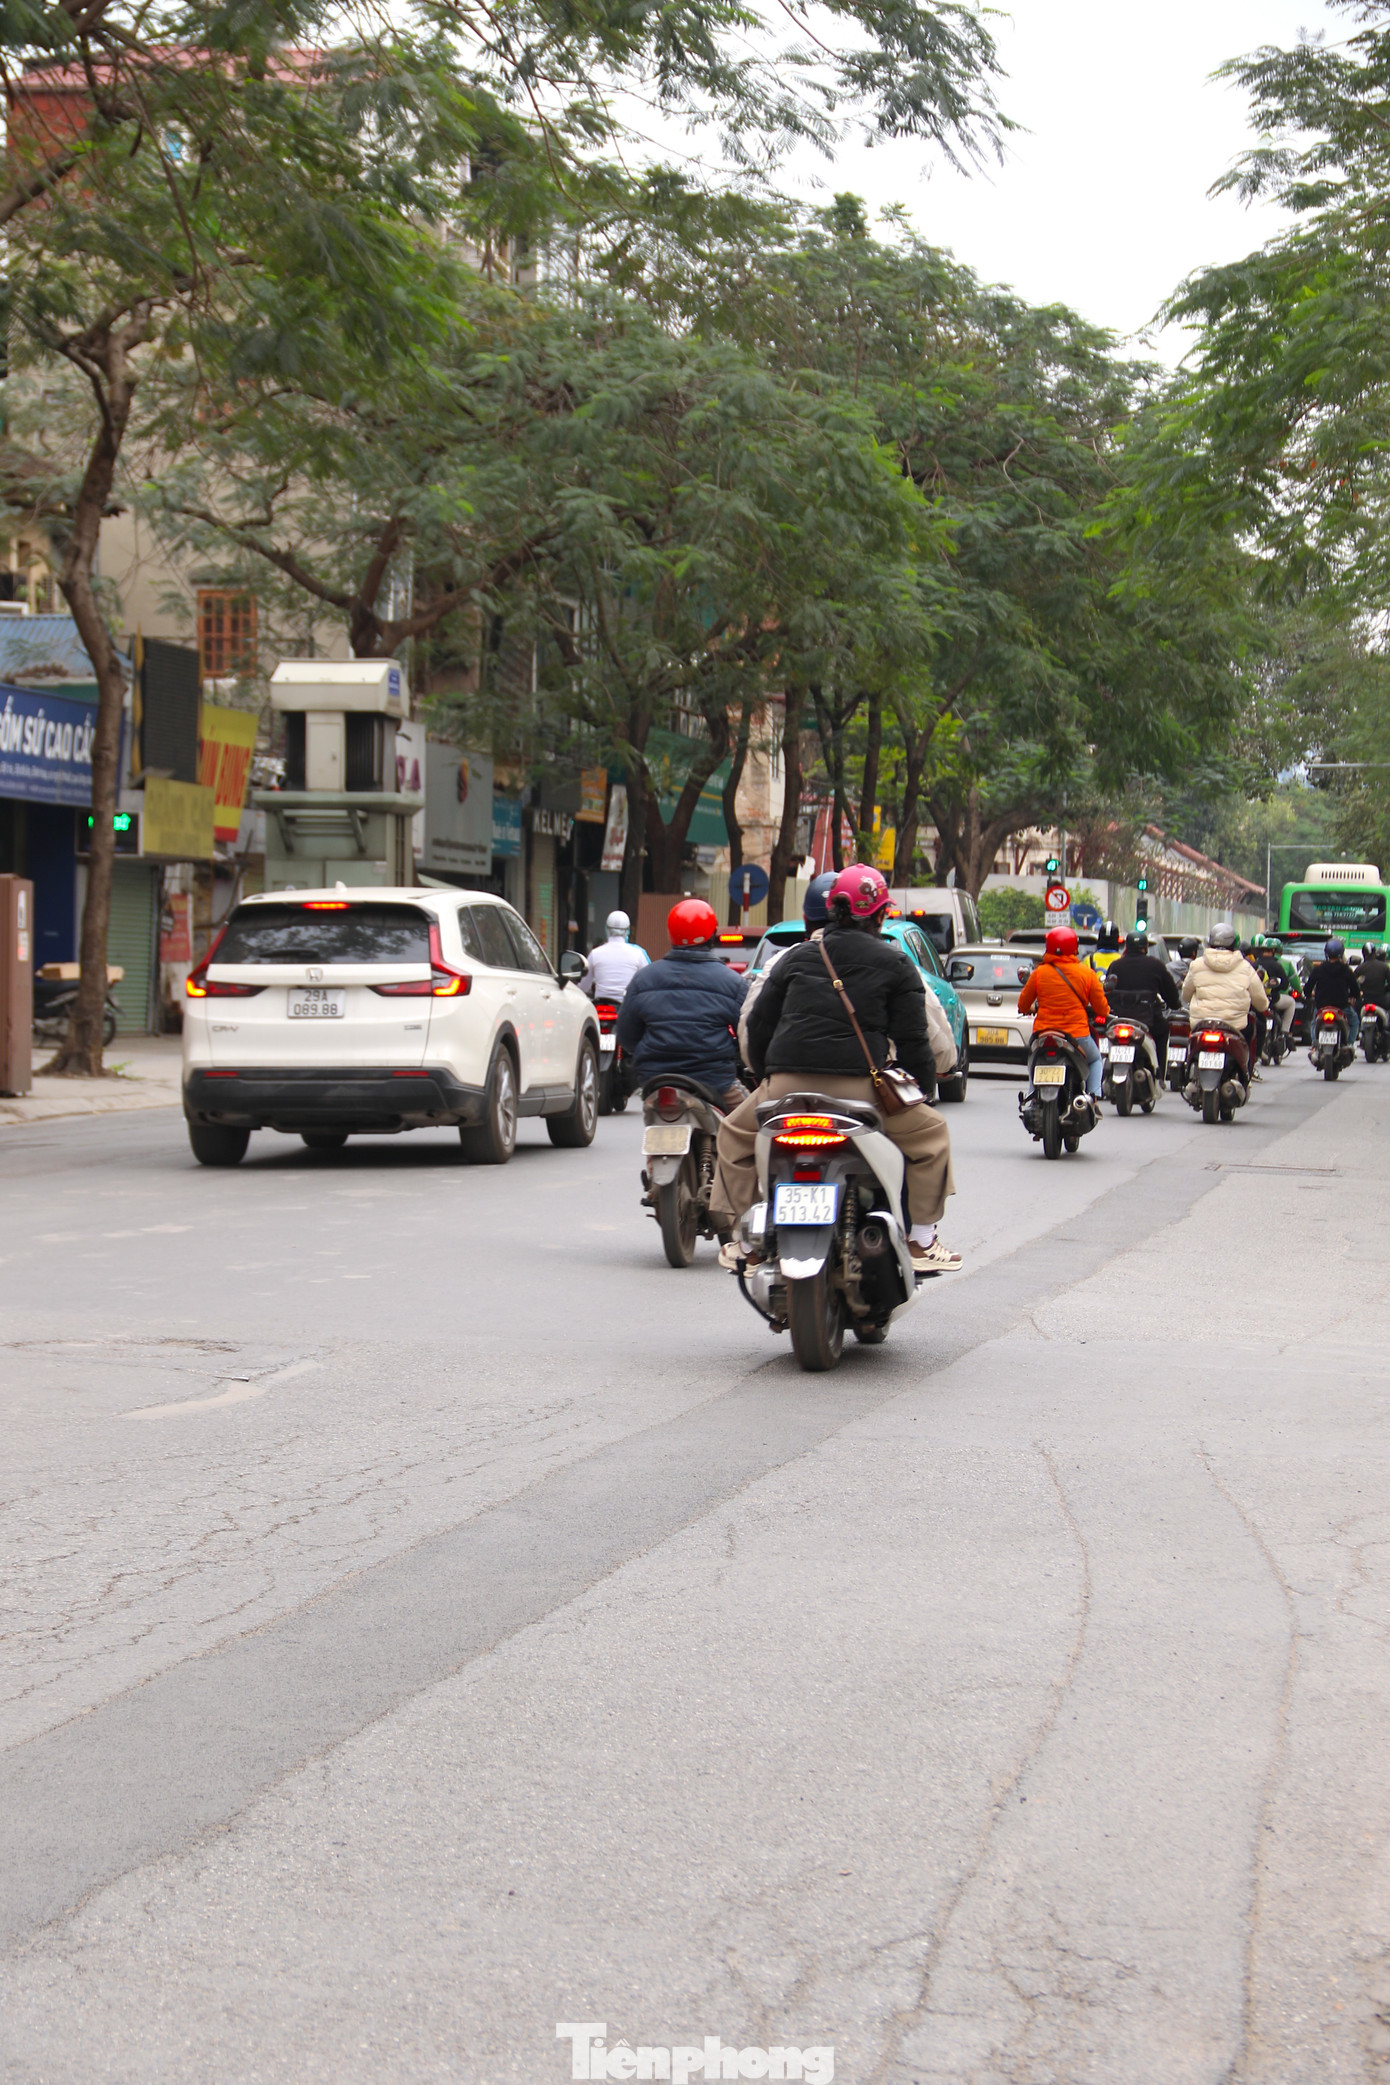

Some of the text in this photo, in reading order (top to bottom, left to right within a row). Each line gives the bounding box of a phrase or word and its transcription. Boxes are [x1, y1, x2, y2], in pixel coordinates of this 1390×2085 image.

[0, 695, 24, 753] ỐM
[22, 708, 47, 757] SỨ
[44, 720, 73, 762] CAO
[305, 989, 328, 1002] 29A
[785, 1187, 826, 1204] 35-K1
[778, 1205, 832, 1222] 513.42
